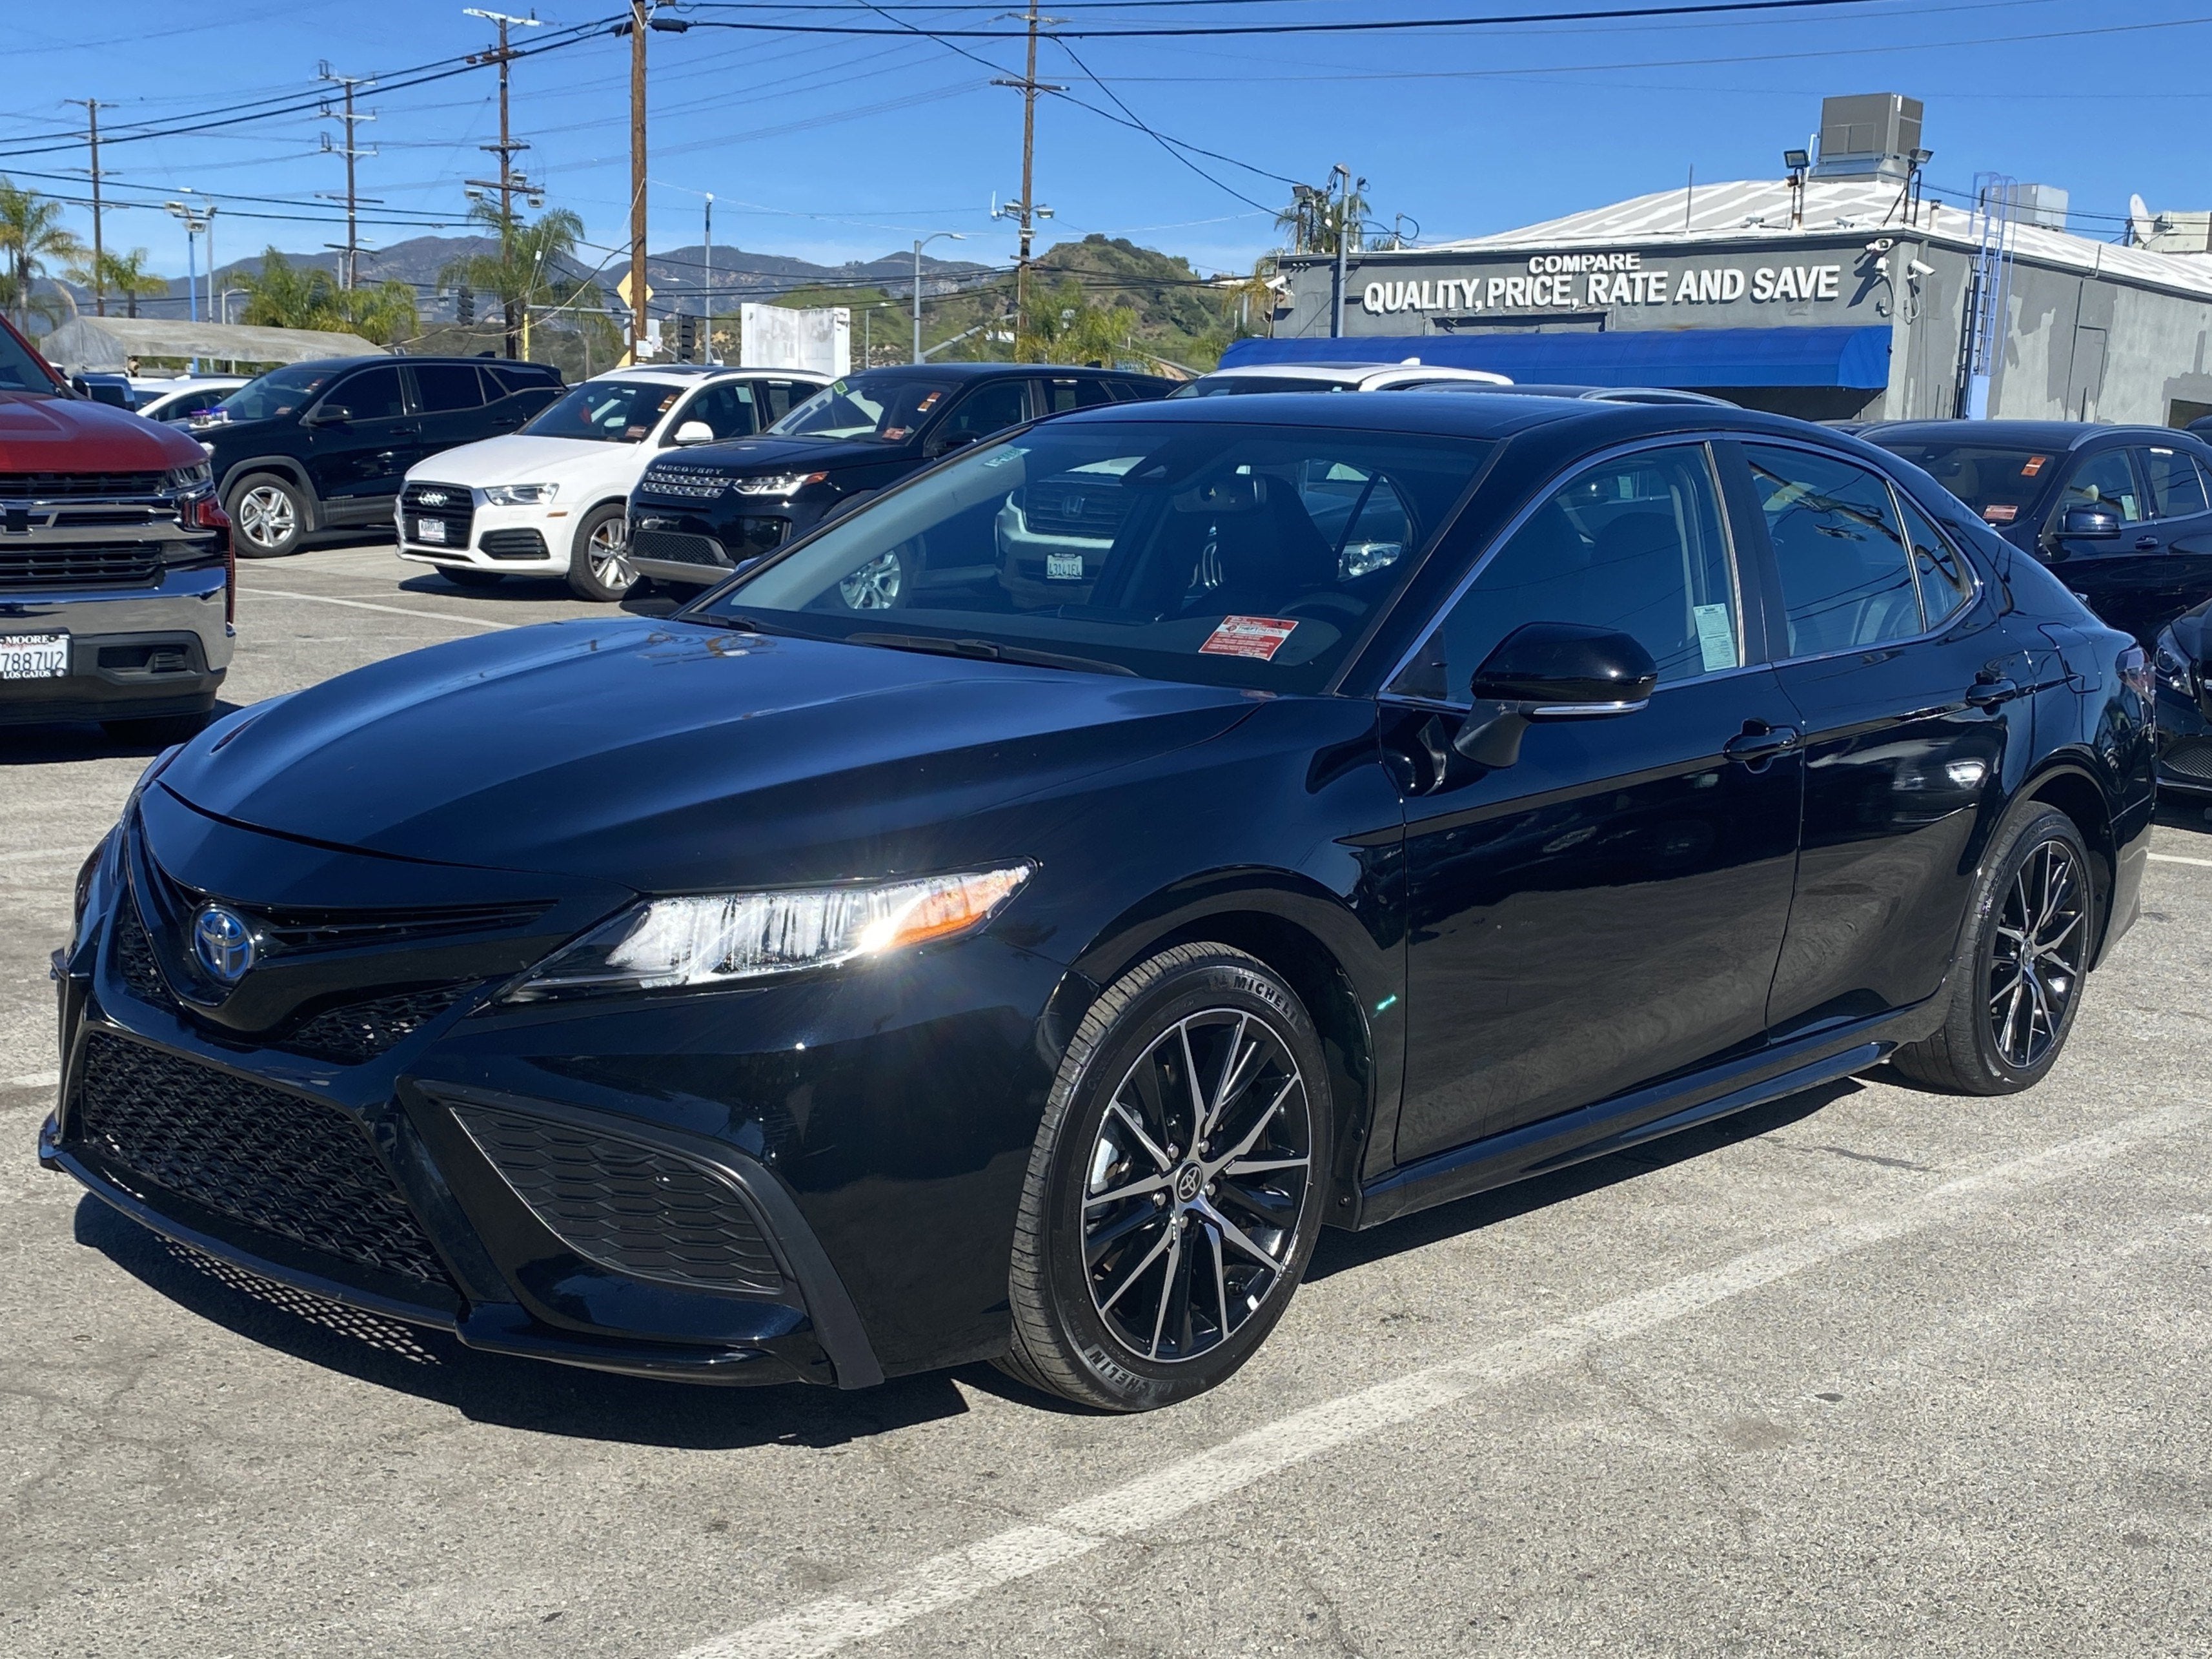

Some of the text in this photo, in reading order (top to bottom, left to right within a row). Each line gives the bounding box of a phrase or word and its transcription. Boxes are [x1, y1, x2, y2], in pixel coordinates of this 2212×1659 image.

[1528, 252, 1641, 274] COMPARE
[1363, 265, 1841, 314] QUALITY, PRICE, RATE AND SAVE
[656, 464, 724, 474] DISCOVERY
[5, 635, 50, 645] MOORE
[0, 651, 64, 672] 7887U2
[3, 670, 51, 680] LOS GATOS
